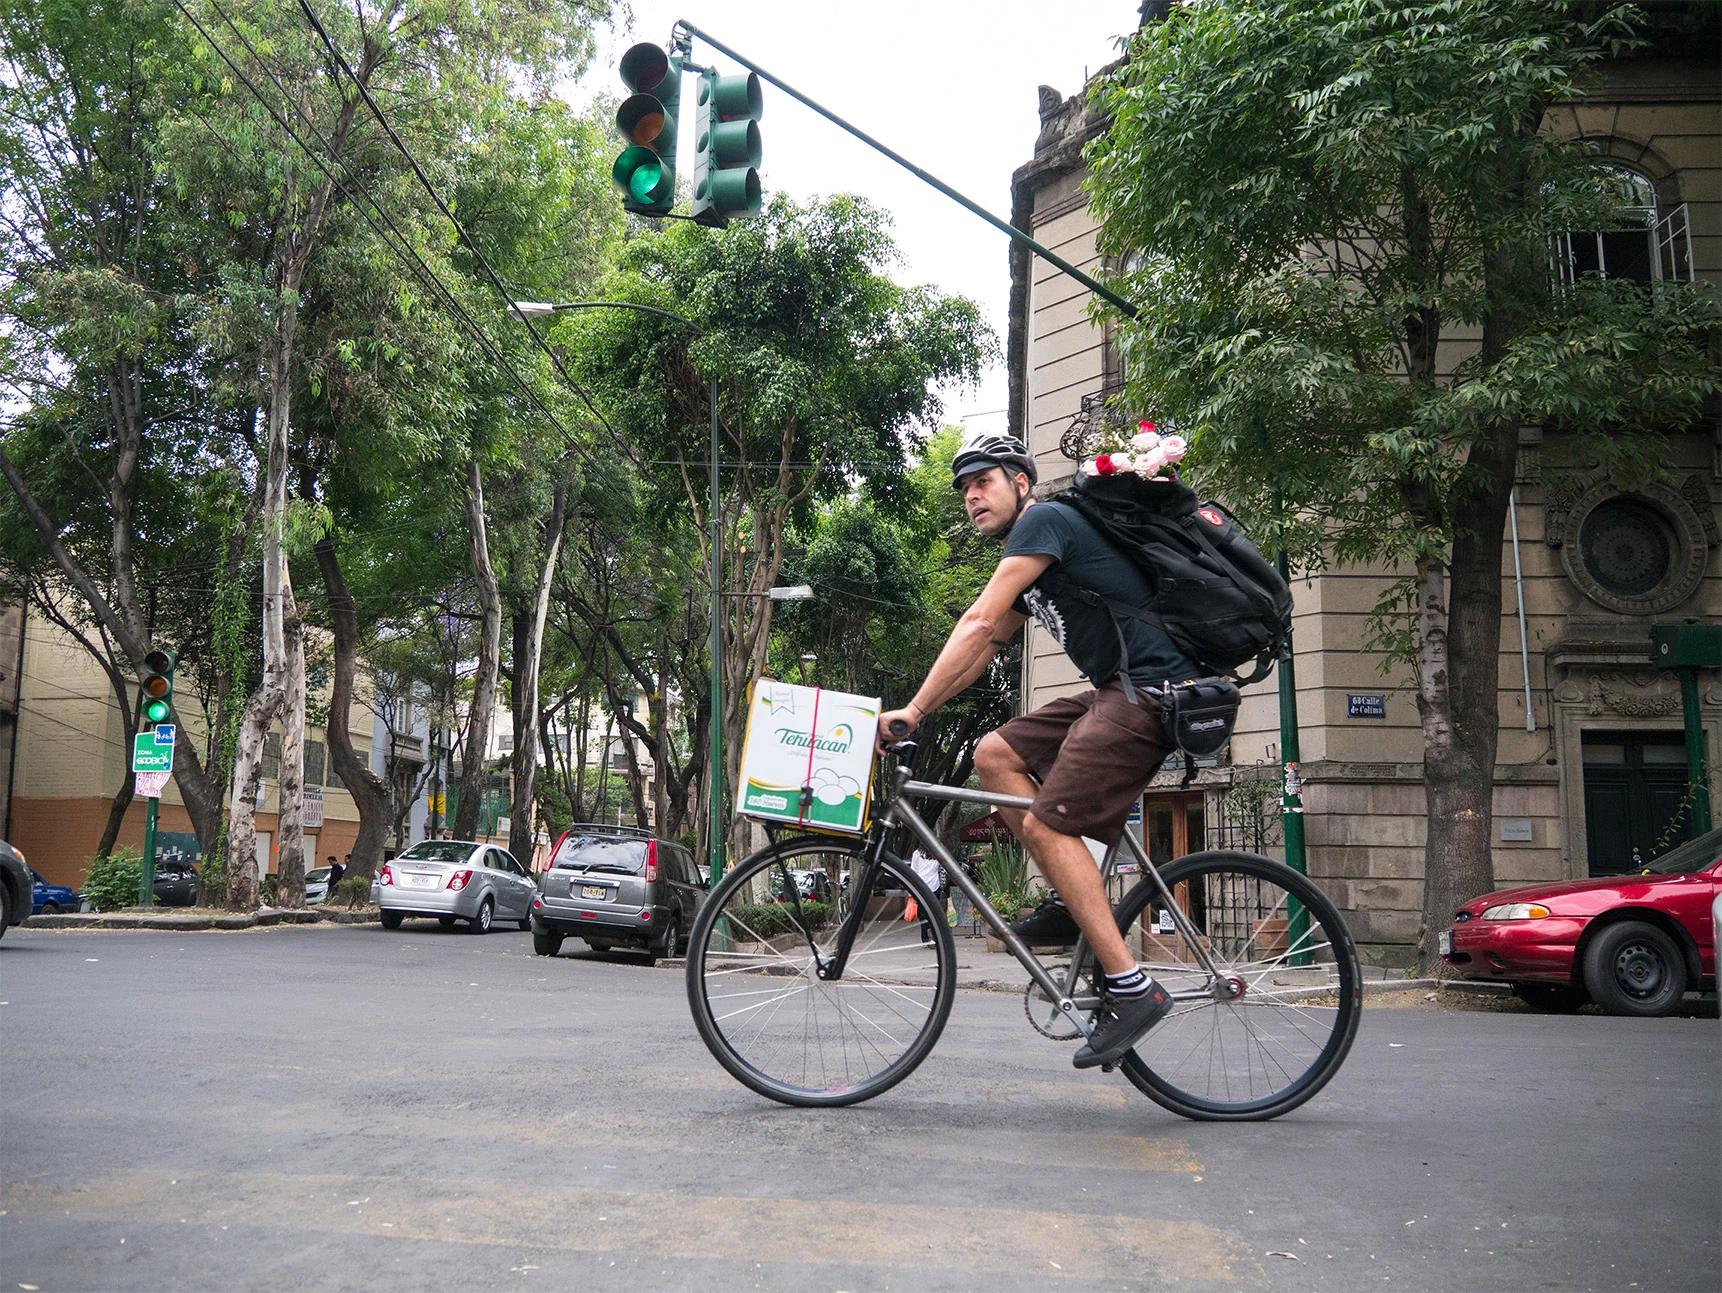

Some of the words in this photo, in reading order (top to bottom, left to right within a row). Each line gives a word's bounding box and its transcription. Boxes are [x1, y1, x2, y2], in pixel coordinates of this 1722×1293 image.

[1361, 696, 1380, 705] Calle
[1350, 705, 1359, 714] de
[1359, 705, 1383, 714] Colima
